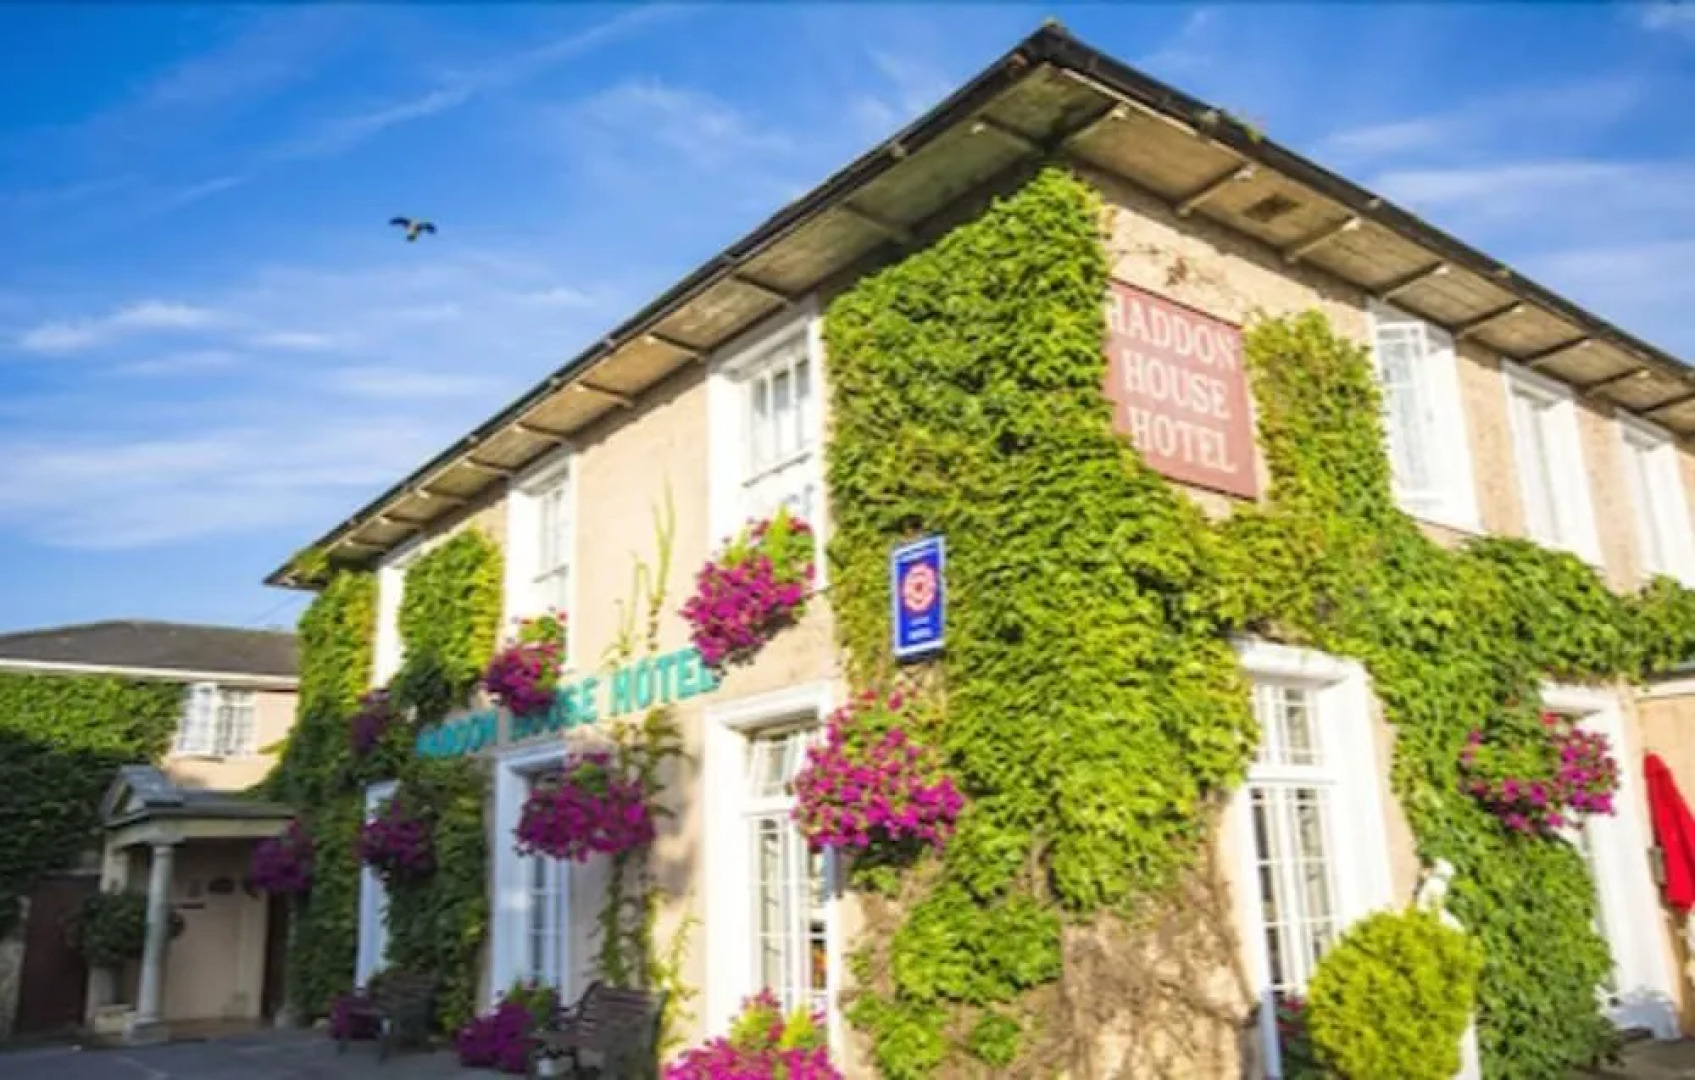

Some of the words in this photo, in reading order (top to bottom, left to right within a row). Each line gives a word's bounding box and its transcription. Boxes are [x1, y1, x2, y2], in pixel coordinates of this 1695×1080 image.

[1121, 348, 1232, 419] HOUSE
[1128, 405, 1238, 474] HOTEL
[609, 648, 721, 716] HOTEL
